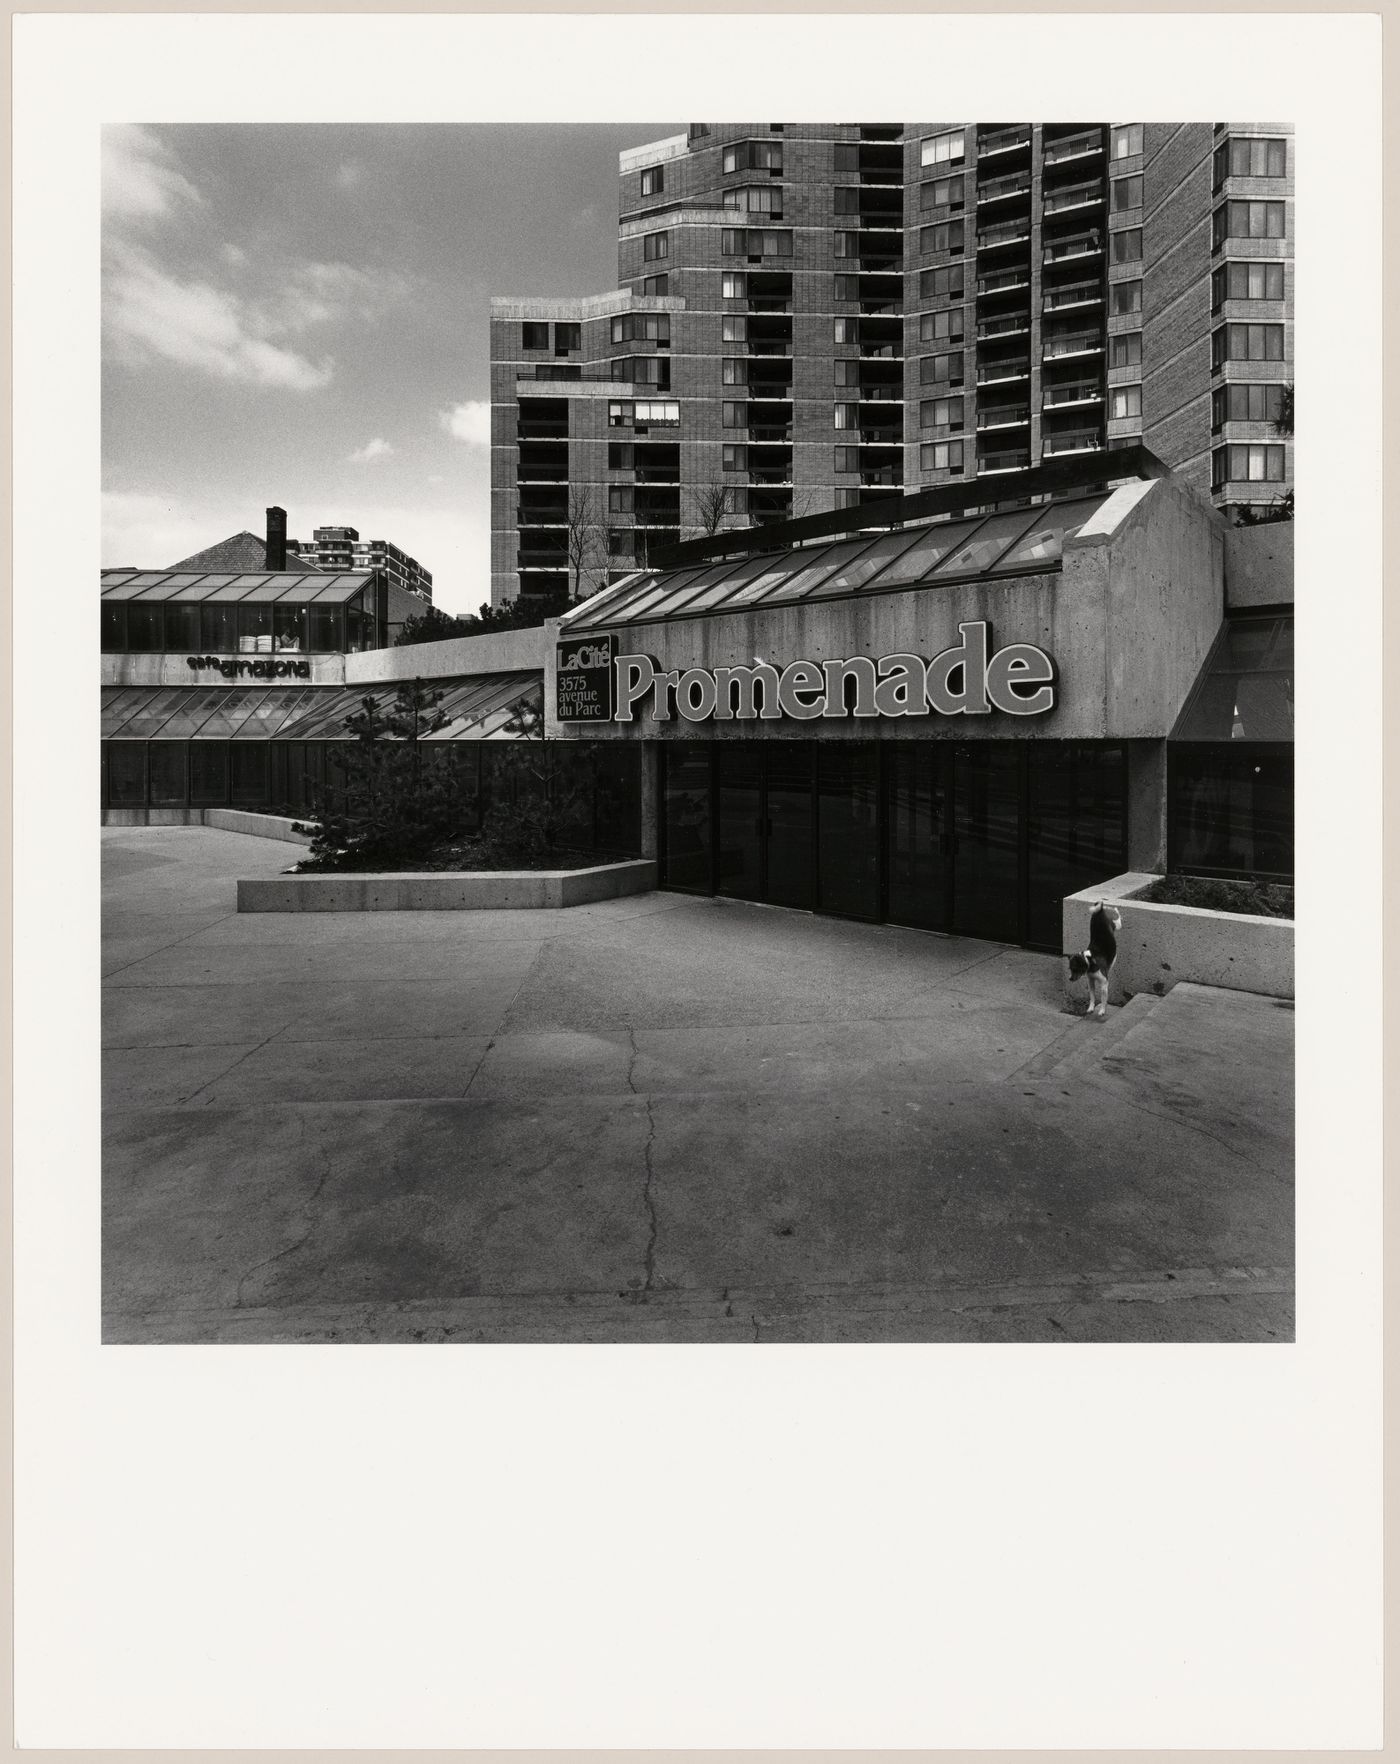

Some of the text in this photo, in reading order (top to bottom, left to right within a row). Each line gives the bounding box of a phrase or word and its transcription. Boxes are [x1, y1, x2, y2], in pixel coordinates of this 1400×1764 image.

[220, 660, 310, 678] amazona
[614, 620, 1055, 722] Promenade
[559, 676, 587, 691] 3575
[559, 690, 598, 702] avenue
[559, 701, 601, 716] du Parc
